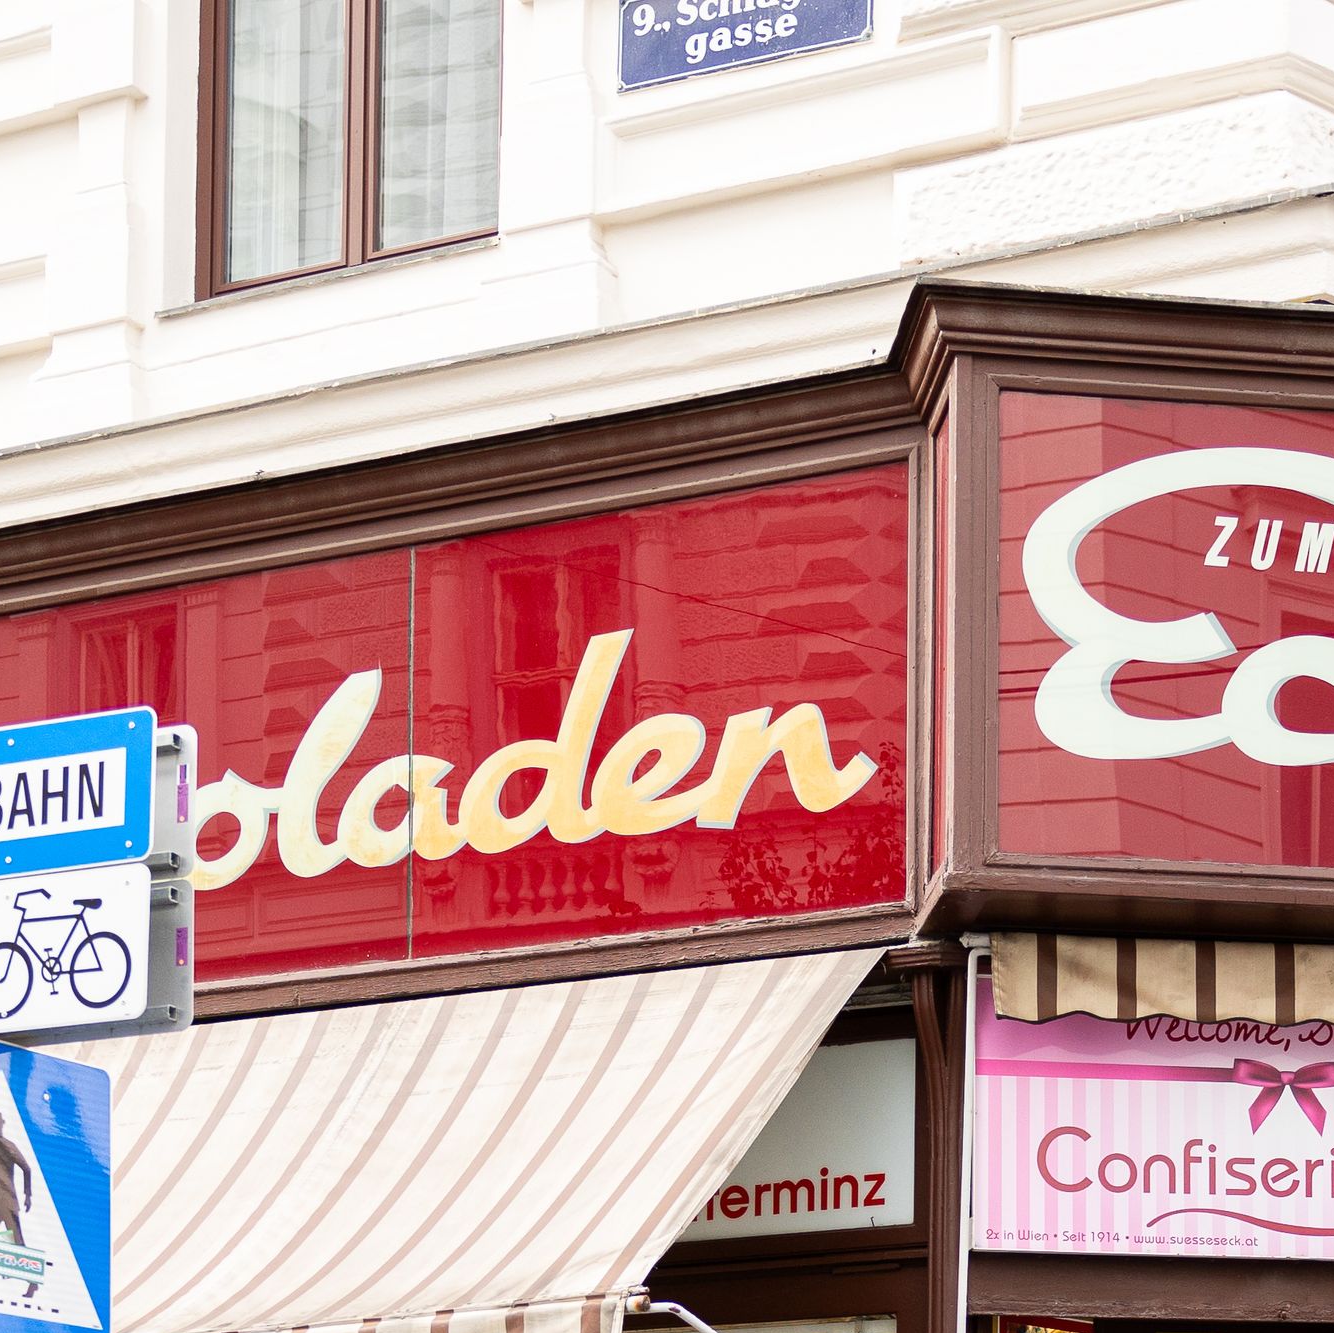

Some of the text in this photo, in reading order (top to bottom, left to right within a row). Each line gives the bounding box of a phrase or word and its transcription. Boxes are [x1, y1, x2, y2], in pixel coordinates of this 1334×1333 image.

[685, 13, 798, 63] gasse
[986, 1229, 1259, 1247] 2x in Wien Seit 1914 www.suesseseck.at
